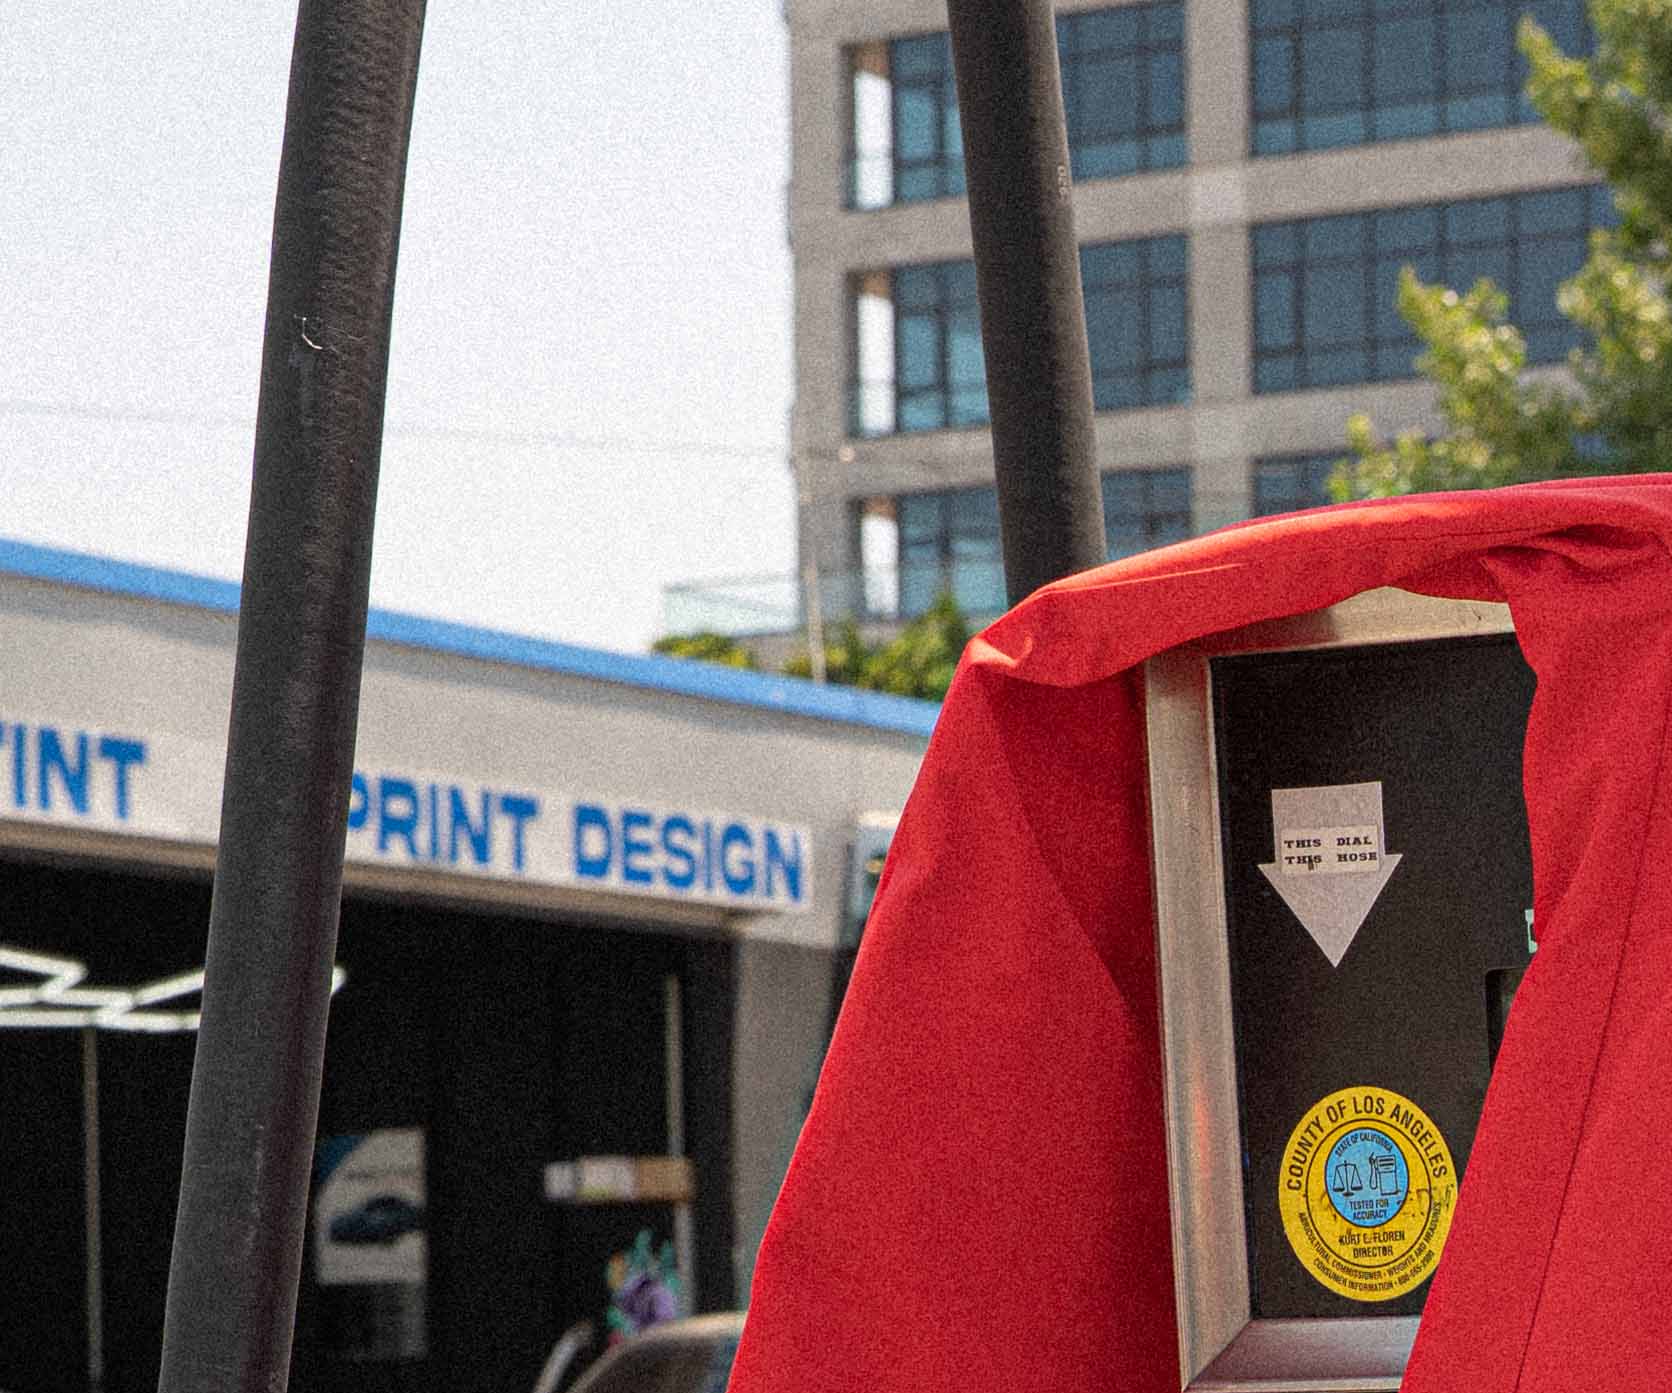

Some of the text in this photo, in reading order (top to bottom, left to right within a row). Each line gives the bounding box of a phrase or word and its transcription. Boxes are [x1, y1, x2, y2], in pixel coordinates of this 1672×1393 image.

[0, 720, 146, 820] INT
[573, 803, 803, 904] DESIGN
[1284, 836, 1373, 849] THIS DIAL
[1284, 852, 1378, 865] THIS HOSE
[1286, 1095, 1448, 1192] COUNTY OF LOS ANGELES
[1339, 1232, 1361, 1246] KURT
[1373, 1230, 1406, 1243] FLOREN
[1352, 1245, 1395, 1259] DIRECTOR
